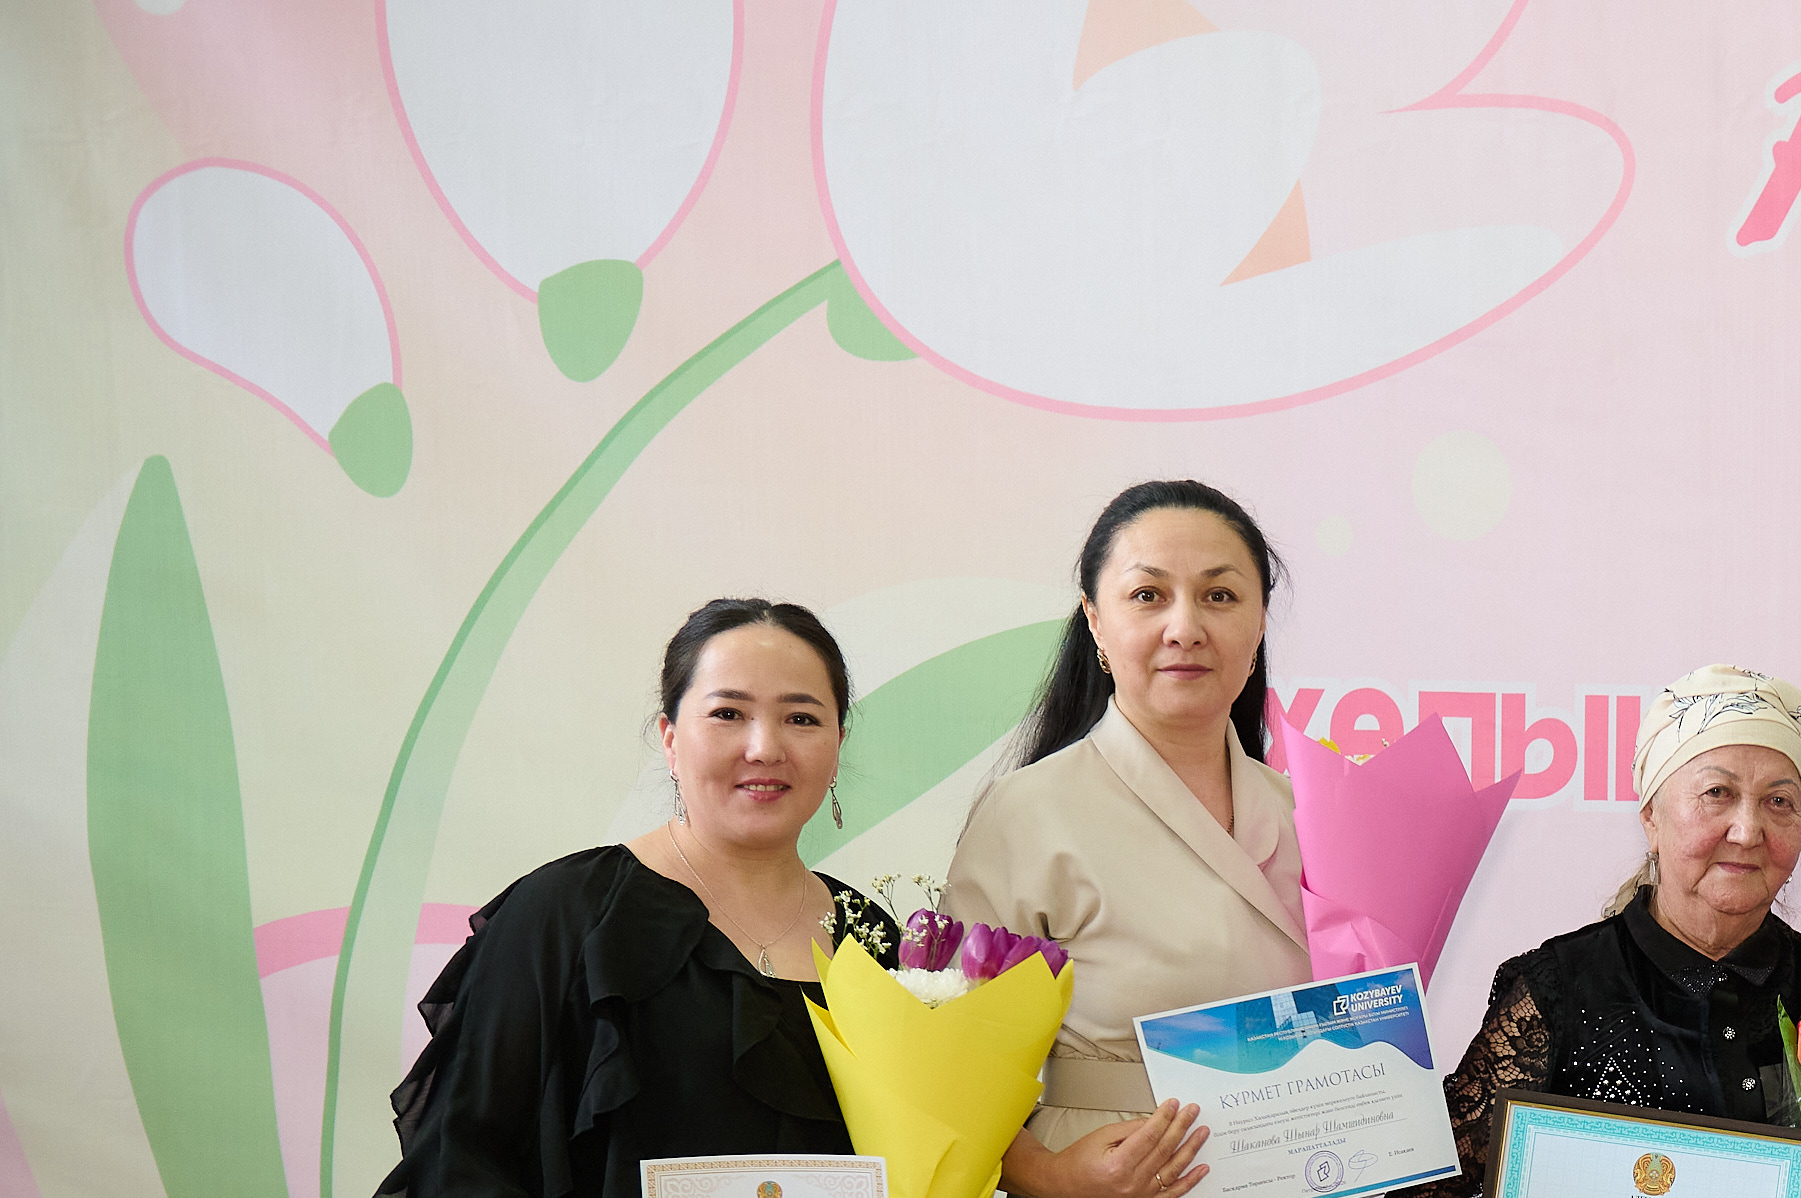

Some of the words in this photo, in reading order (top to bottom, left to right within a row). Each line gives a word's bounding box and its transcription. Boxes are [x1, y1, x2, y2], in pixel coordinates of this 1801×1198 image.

[1350, 984, 1402, 1003] KOZYBAYEV
[1350, 994, 1403, 1013] UNIVERSITY
[1219, 1083, 1281, 1109] ҚҰРМЕТ
[1286, 1062, 1385, 1095] ГРАМОТАСЫ
